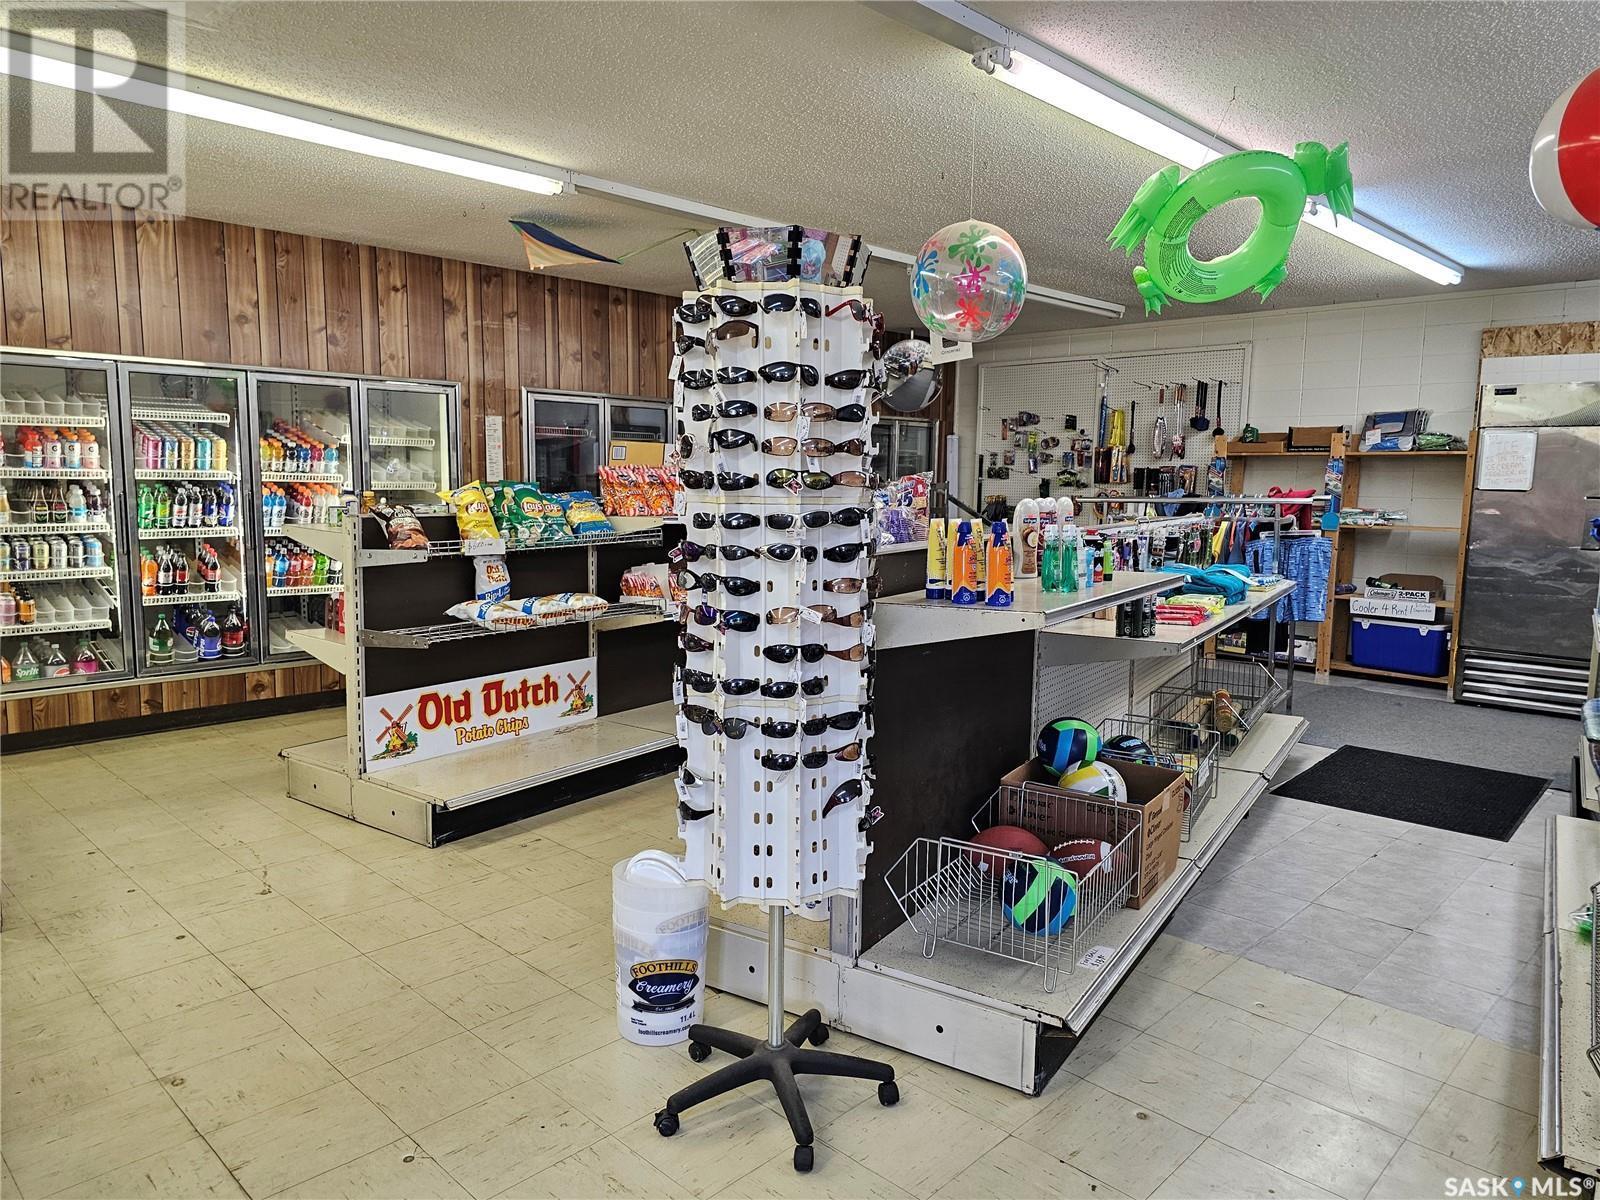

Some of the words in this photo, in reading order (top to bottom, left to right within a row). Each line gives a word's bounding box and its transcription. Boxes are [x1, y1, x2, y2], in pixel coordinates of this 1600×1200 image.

[1351, 599, 1379, 614] Cooler
[1381, 602, 1389, 617] 4
[417, 689, 472, 730] Old
[481, 674, 559, 717] Dutch
[455, 723, 495, 746] Potato
[495, 716, 530, 737] Chips
[632, 961, 697, 977] FOOTHILLS
[636, 978, 694, 995] Creamery
[638, 1024, 691, 1036] foothillscreamery.com
